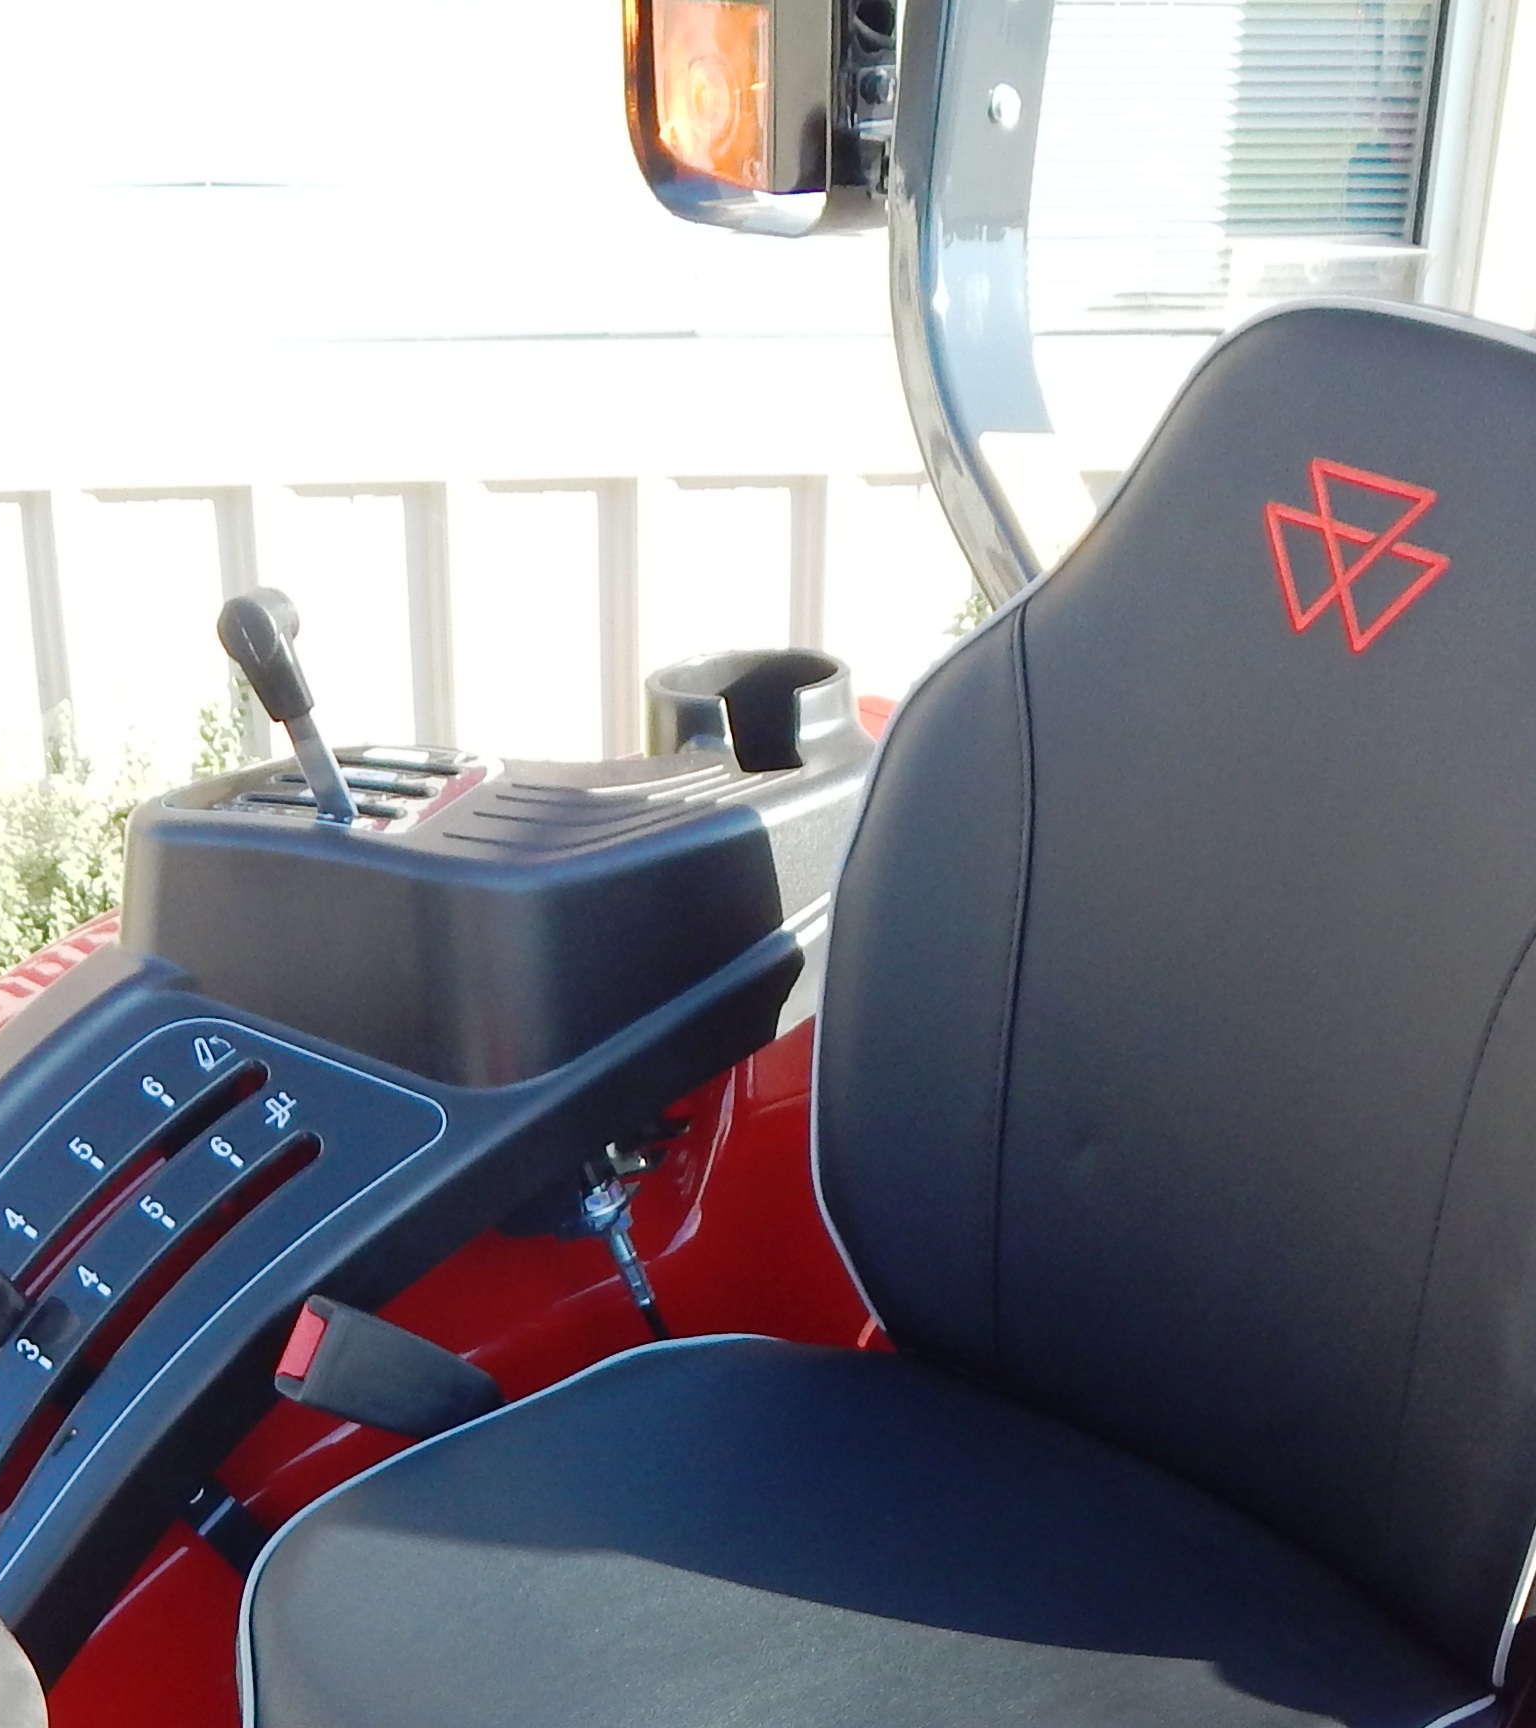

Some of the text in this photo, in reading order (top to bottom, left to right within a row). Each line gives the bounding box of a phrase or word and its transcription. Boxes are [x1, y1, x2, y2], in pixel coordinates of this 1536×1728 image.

[142, 1076, 164, 1097] 6
[69, 1136, 93, 1160] 5
[210, 1136, 233, 1157] 6
[5, 1207, 26, 1230] 4
[139, 1195, 164, 1219] 5
[77, 1265, 99, 1287] 4
[16, 1338, 40, 1361] 3
